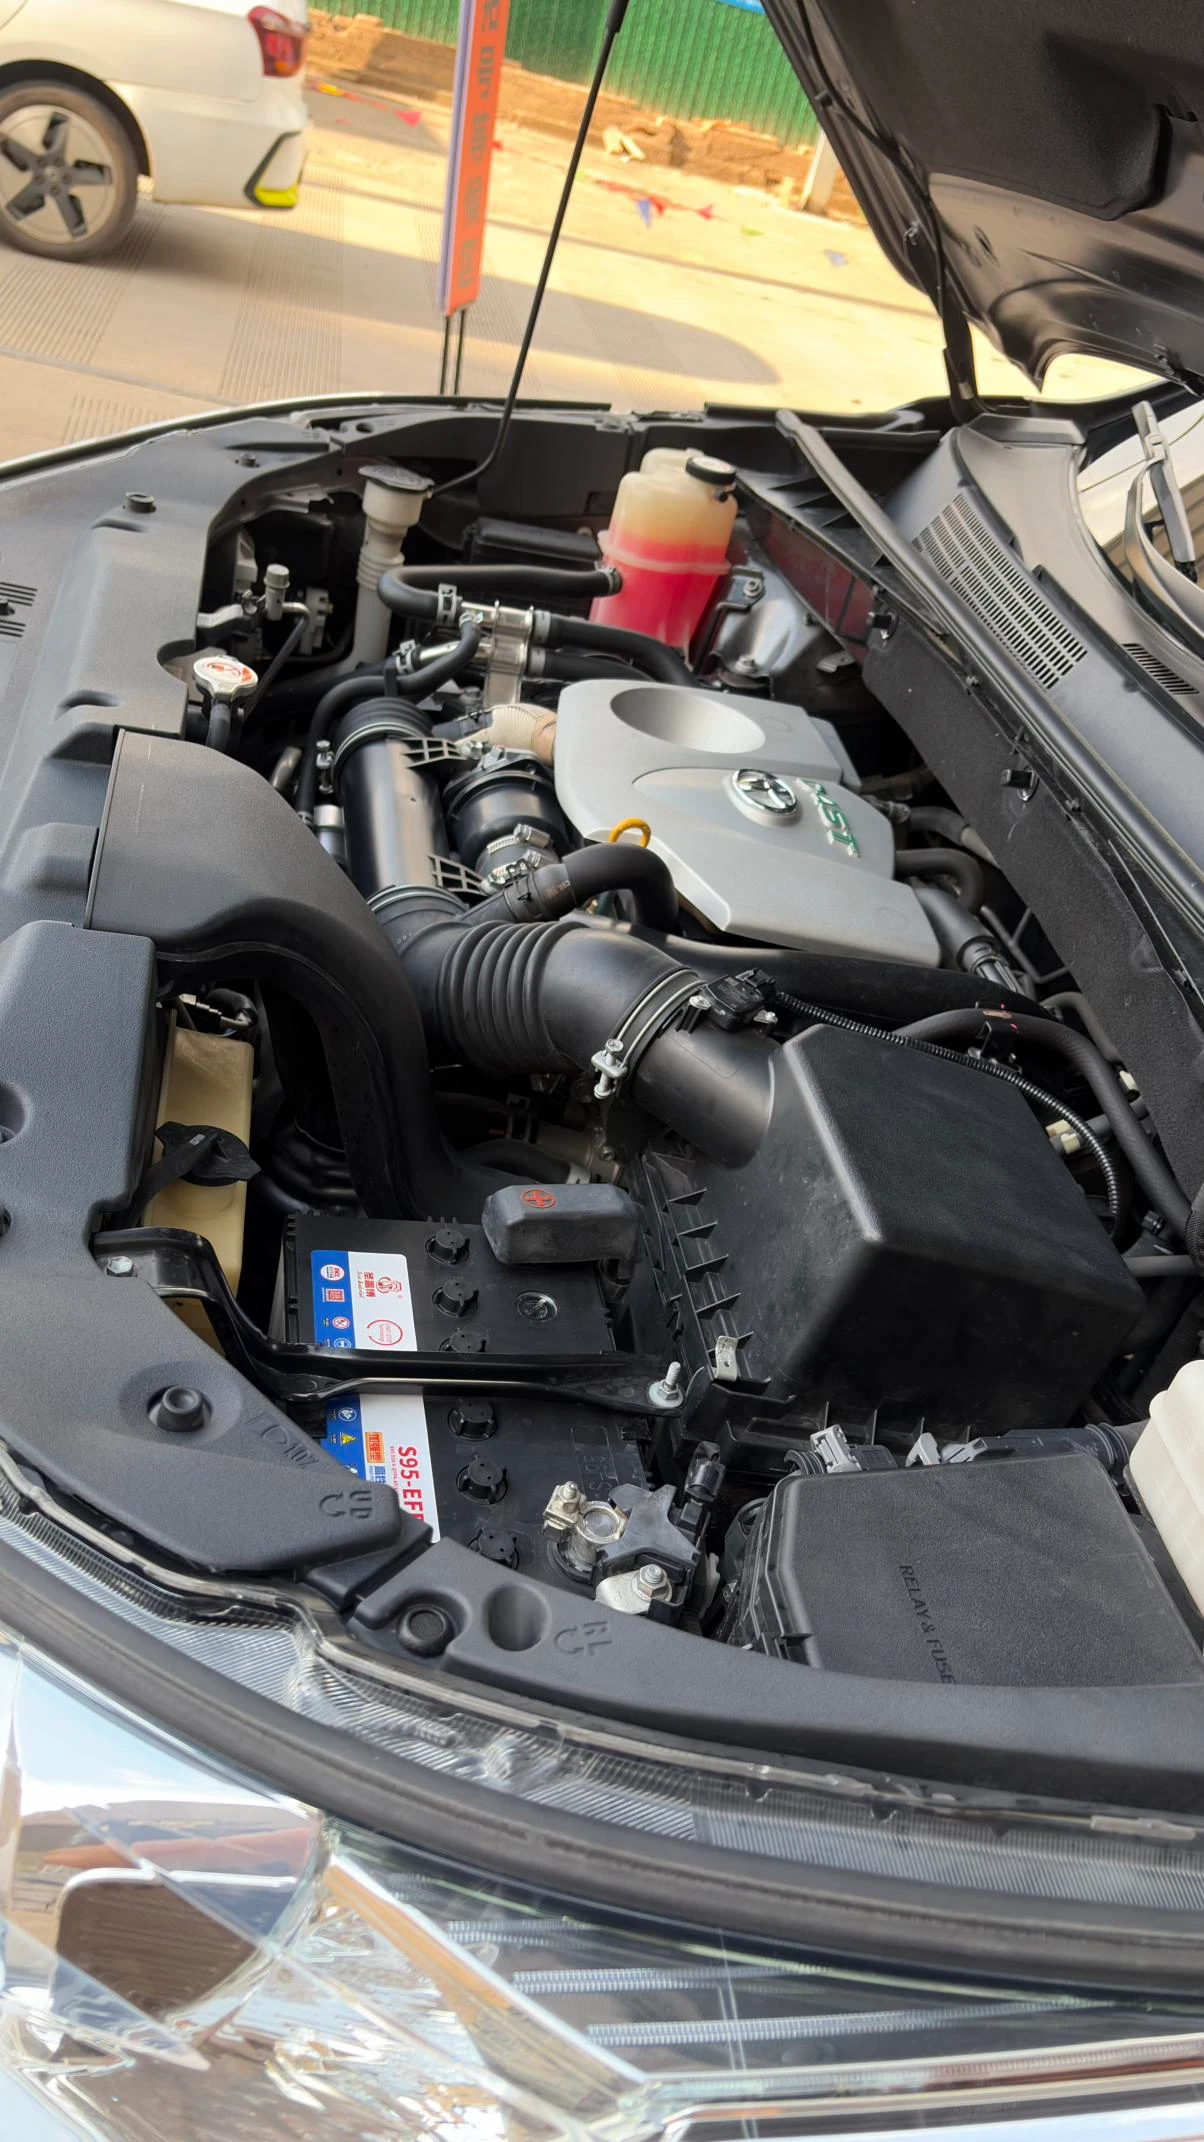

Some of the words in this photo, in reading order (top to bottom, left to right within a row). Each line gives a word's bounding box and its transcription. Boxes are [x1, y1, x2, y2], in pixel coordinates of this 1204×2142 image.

[900, 1565, 932, 1620] RELAY
[921, 1621, 936, 1633] &
[926, 1639, 957, 1685] FUSE
